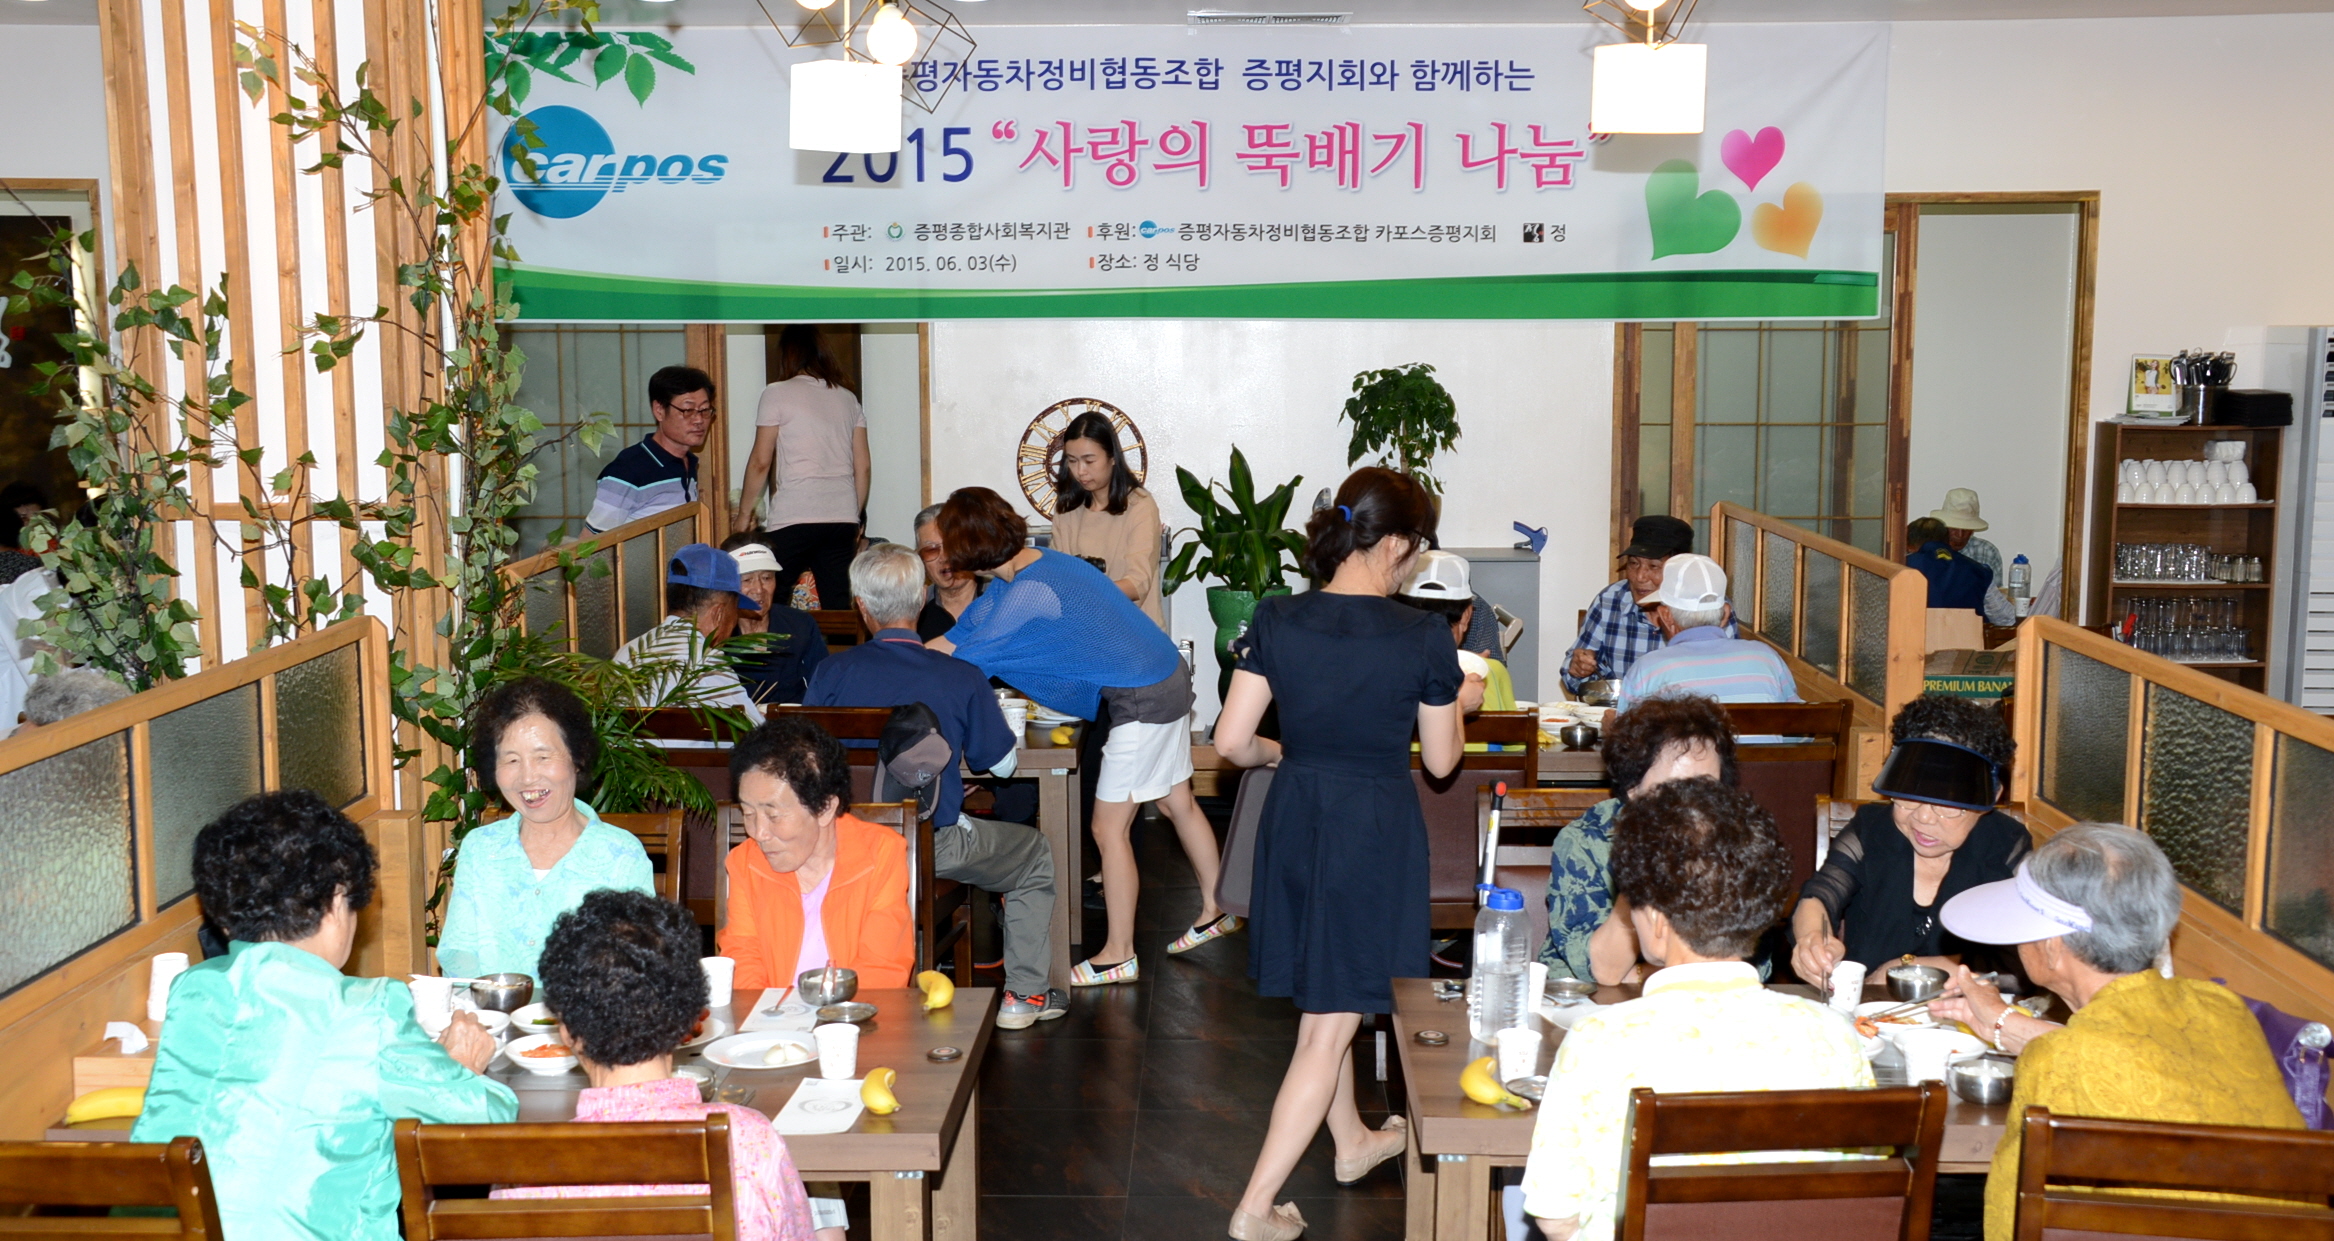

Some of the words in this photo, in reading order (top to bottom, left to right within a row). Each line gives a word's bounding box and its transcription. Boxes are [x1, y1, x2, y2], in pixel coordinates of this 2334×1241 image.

[901, 57, 1224, 92] 평자동차정비협동조합
[1242, 58, 1400, 91] 증평지회와
[1410, 59, 1535, 92] 함께하는
[1235, 121, 1424, 189] 뚝배기
[510, 152, 730, 193] carpos
[832, 223, 872, 242] 주관:
[914, 222, 1070, 242] 증평종합사회복지관
[1097, 222, 1137, 241] 후원:
[1178, 222, 1370, 243] 증평자동차정비협동조합
[1375, 224, 1496, 243] 카포스증평지회
[1550, 224, 1567, 243] 정
[834, 255, 873, 274] 일시:
[886, 256, 931, 272] 2015.
[936, 256, 962, 272] 06.
[968, 254, 1017, 273] 03(수)
[1098, 253, 1137, 272] 장소:
[1143, 253, 1160, 272] 정
[1166, 253, 1200, 272] 식당
[1923, 680, 1976, 692] PREMIUM
[1977, 680, 2013, 693] BANA
